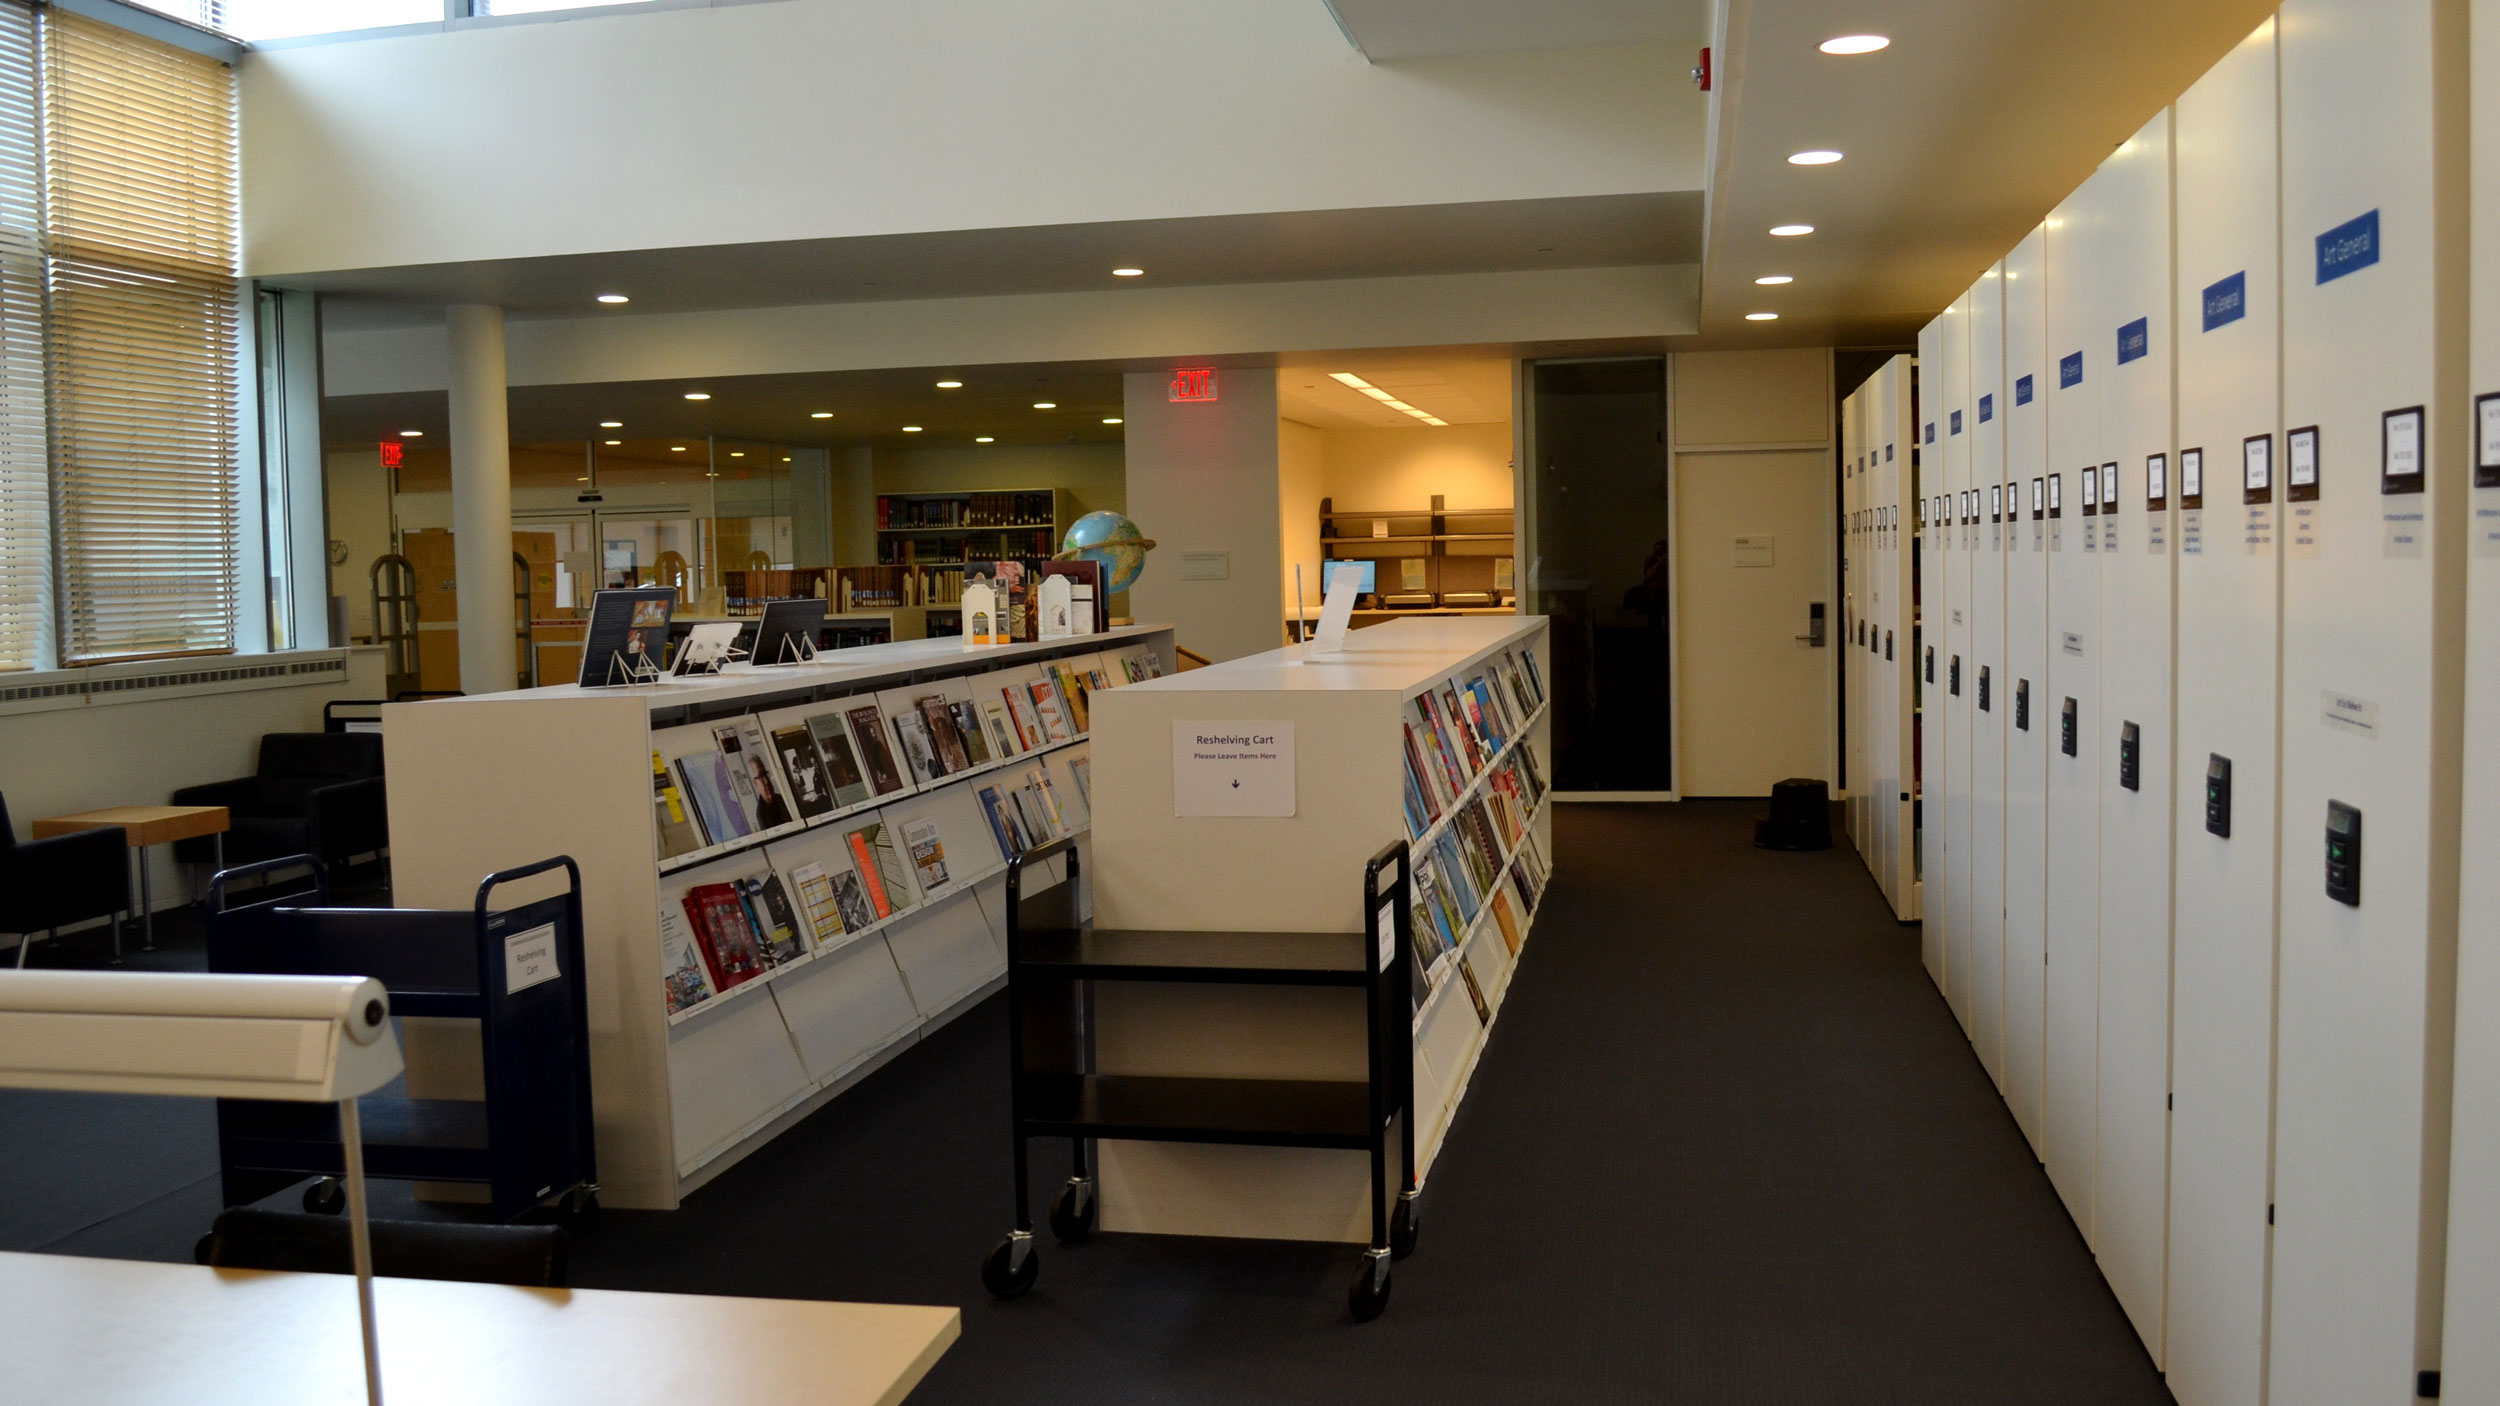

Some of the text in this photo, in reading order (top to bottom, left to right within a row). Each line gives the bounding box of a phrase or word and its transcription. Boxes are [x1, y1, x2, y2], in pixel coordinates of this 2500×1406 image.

[2322, 226, 2370, 268] Art General
[1178, 370, 1211, 397] EXIT
[385, 445, 401, 465] EXIT
[1196, 735, 1274, 746] Reshelving Cart
[1194, 752, 1216, 760] Please
[1239, 752, 1258, 760] Items
[1260, 752, 1277, 760] Here
[516, 947, 546, 963] Reshelving
[526, 964, 539, 976] Cart
